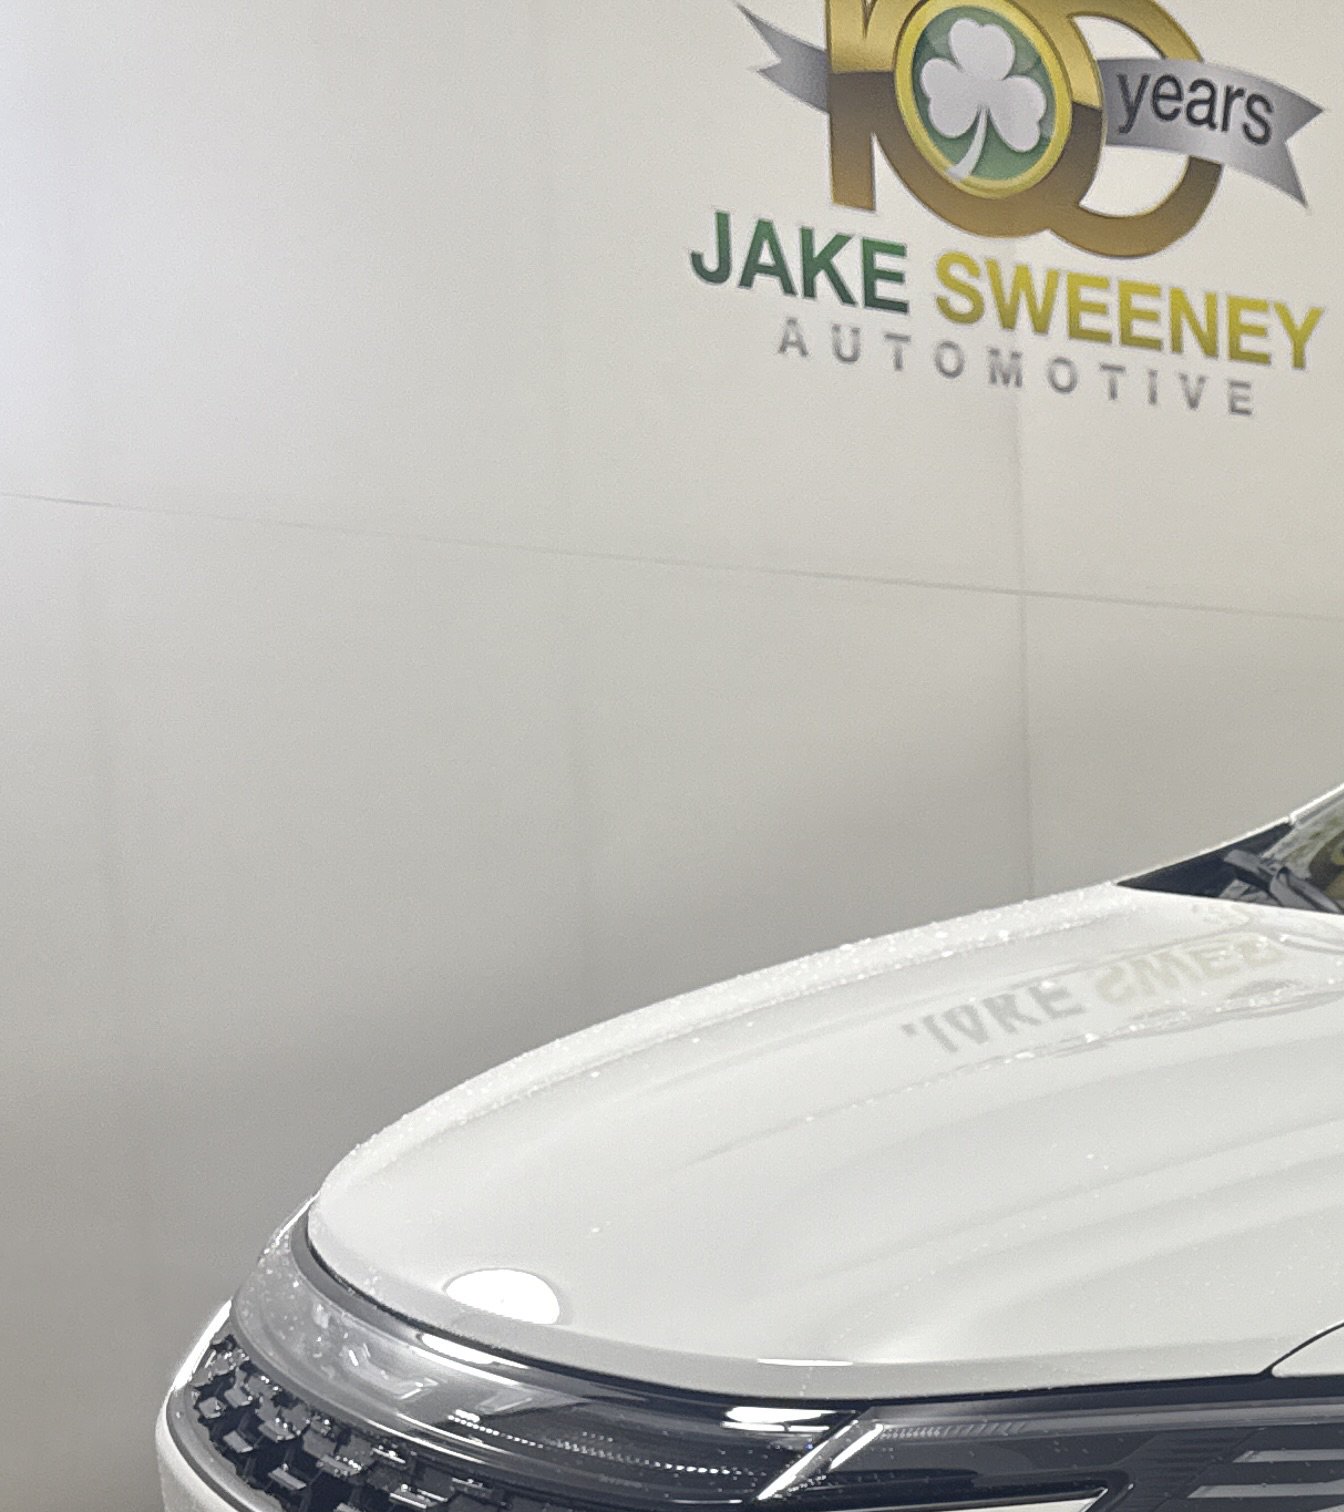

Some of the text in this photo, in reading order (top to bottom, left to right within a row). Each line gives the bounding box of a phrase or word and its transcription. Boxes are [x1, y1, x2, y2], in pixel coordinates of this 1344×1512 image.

[1117, 71, 1275, 146] years
[690, 210, 1325, 370] JAKE SWEENEY
[778, 317, 1254, 417] AUTOMOTIVE
